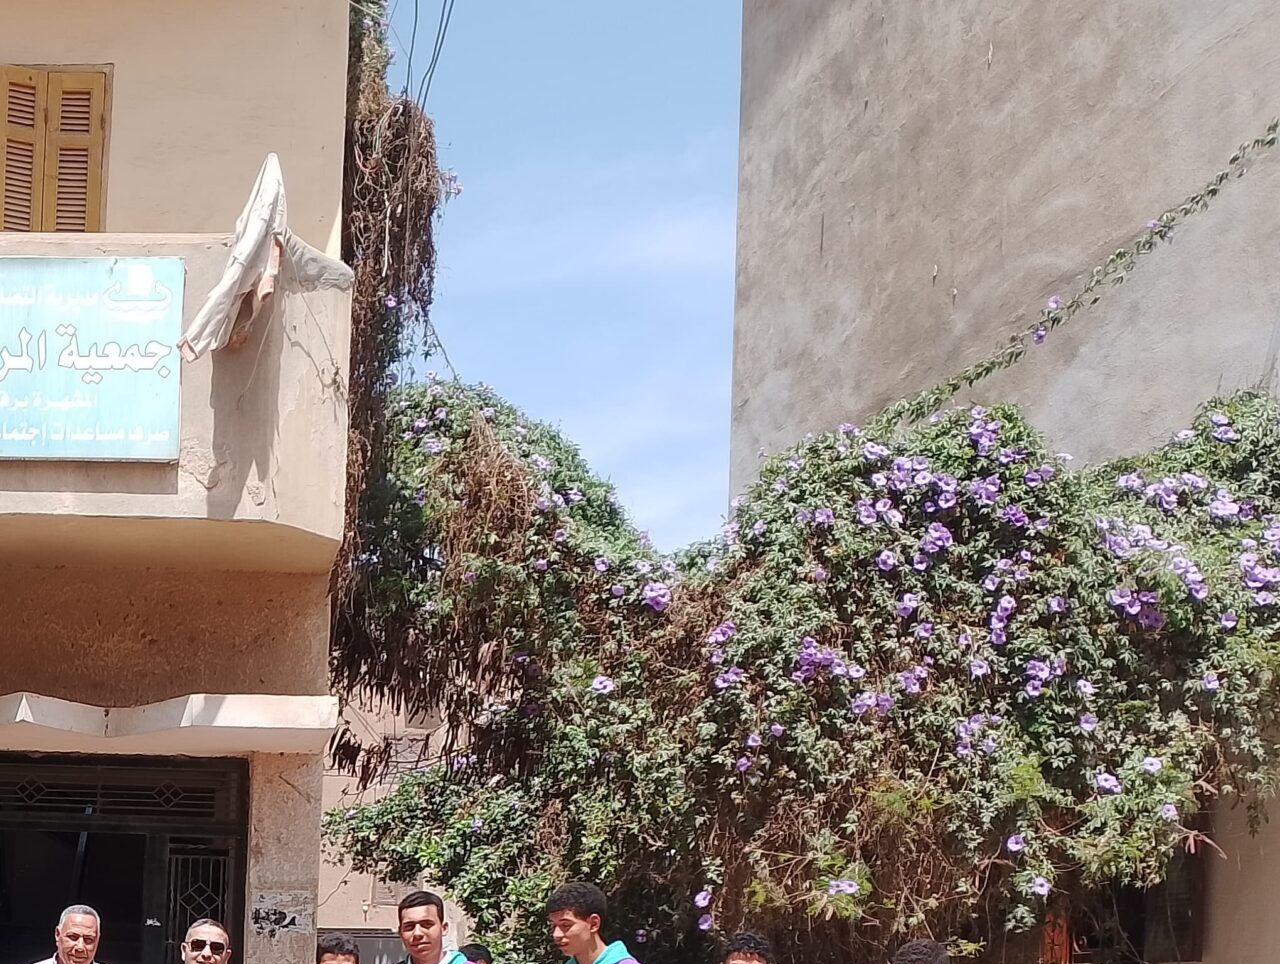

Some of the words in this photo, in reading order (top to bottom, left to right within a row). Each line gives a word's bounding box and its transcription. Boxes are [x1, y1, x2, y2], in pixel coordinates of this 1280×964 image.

[55, 323, 173, 384] جمعية
[49, 421, 126, 442] مساعدات
[126, 423, 170, 446] صرف
